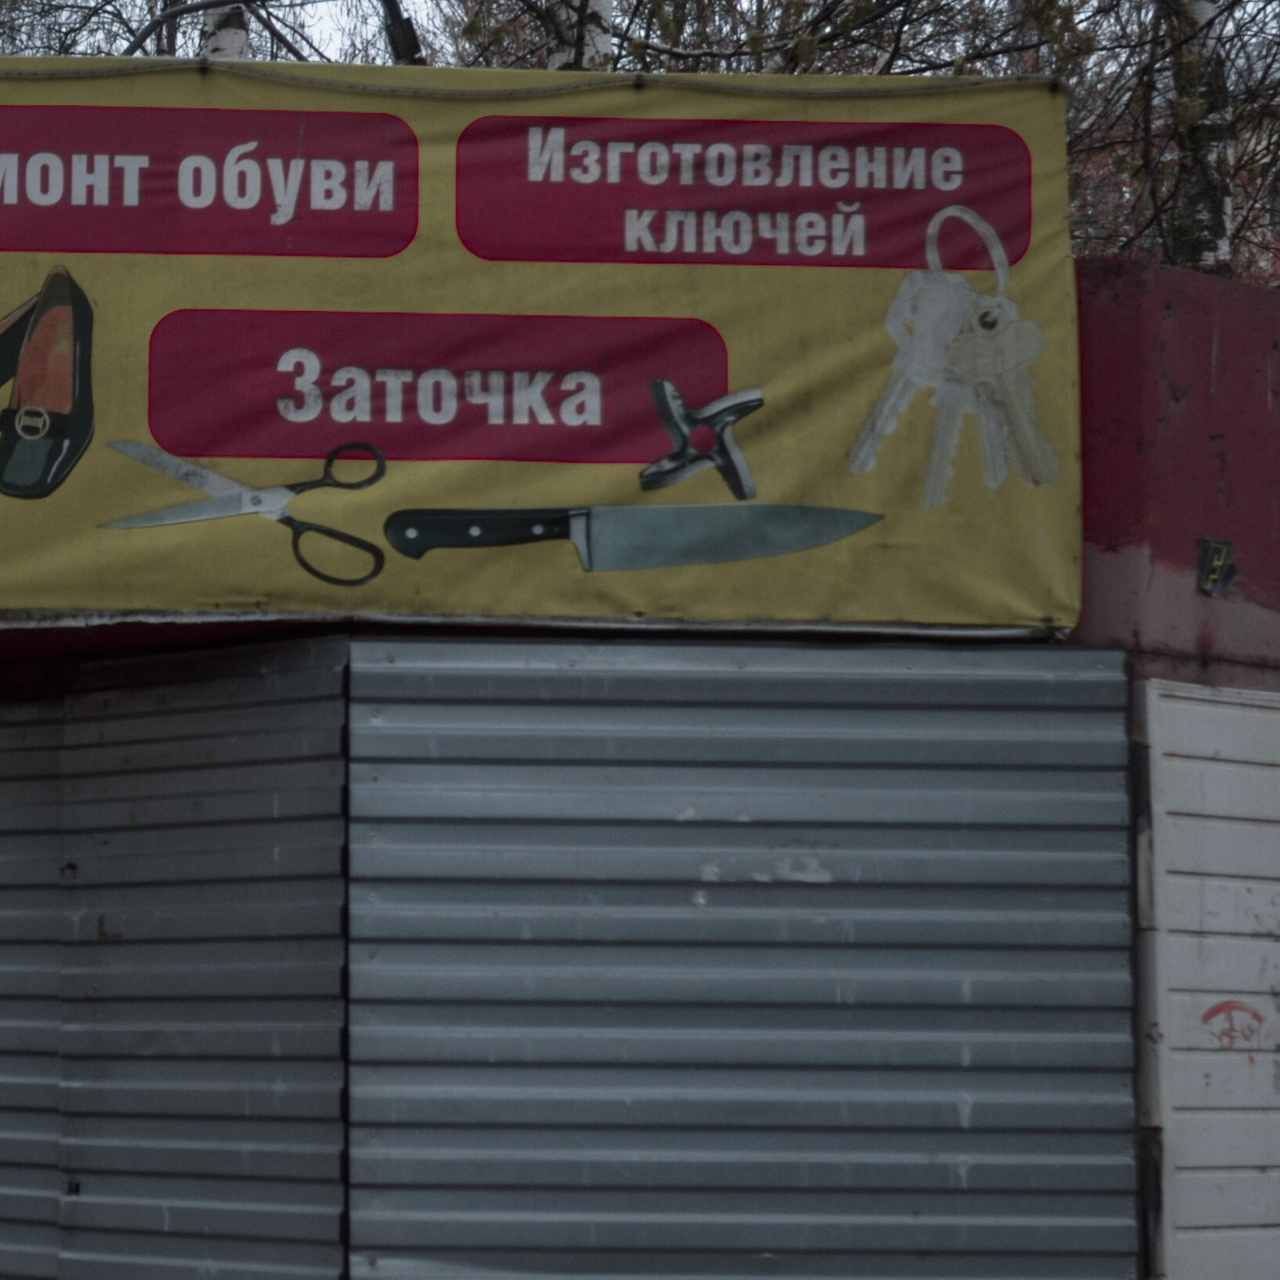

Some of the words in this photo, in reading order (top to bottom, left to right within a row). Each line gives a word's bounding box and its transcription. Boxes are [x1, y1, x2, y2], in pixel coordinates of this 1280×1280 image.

[177, 141, 395, 226] обуви
[527, 126, 964, 191] Изготовление
[623, 201, 867, 257] ключей
[276, 347, 603, 426] Заточка
